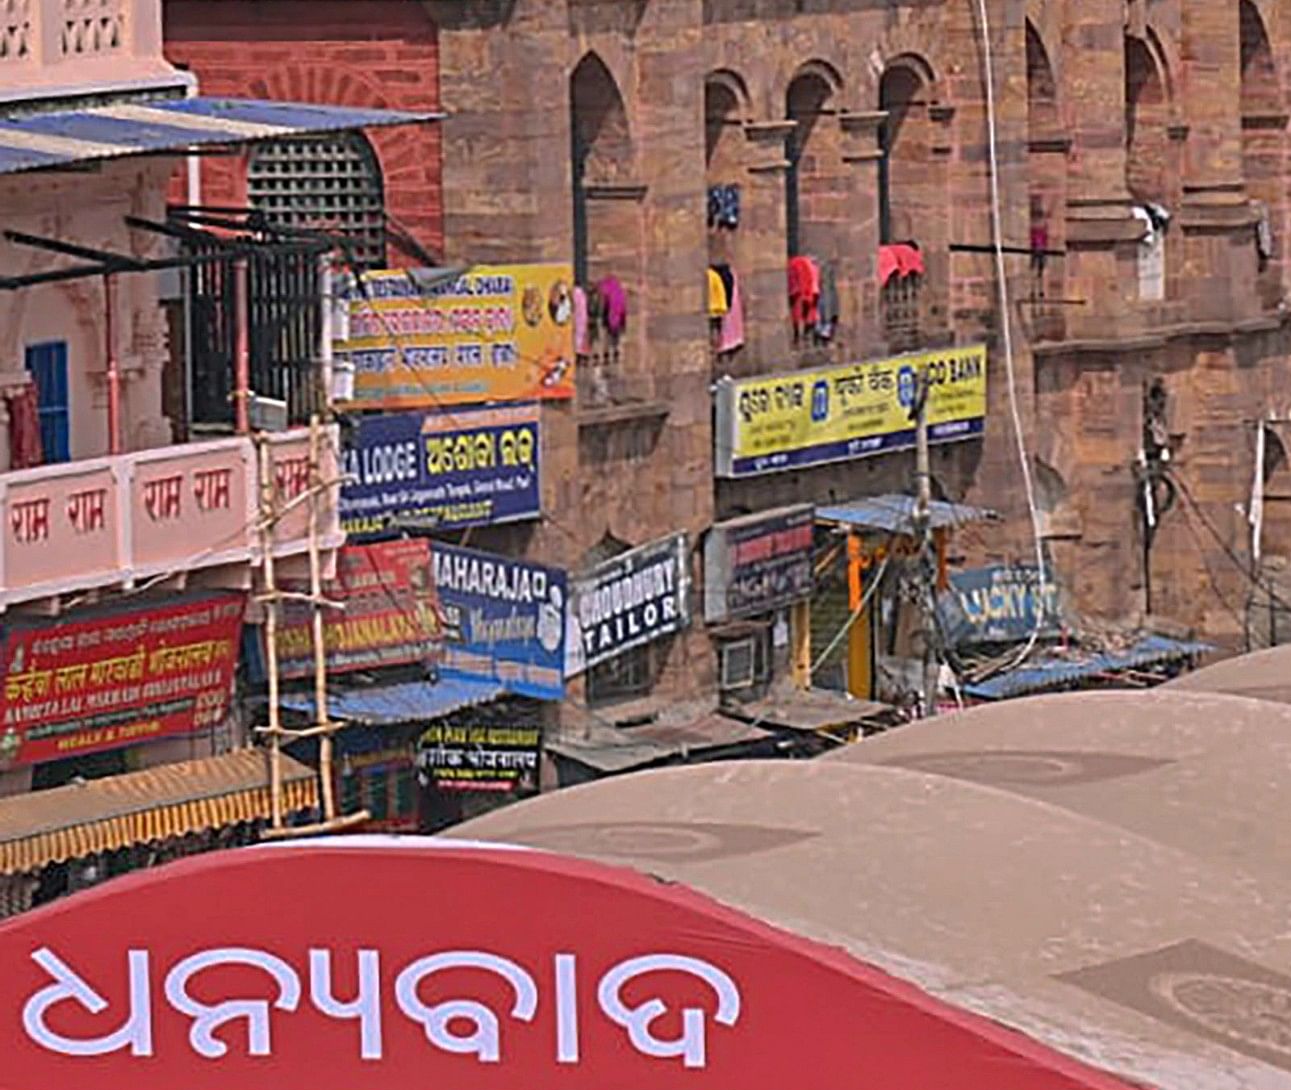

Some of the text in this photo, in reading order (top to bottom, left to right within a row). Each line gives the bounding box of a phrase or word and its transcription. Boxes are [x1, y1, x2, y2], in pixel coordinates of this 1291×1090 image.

[363, 441, 418, 484] LODGE
[11, 489, 107, 542] राम राम
[144, 468, 232, 521] राम राम
[584, 595, 677, 653] TAILOR
[22, 946, 741, 1068] ଧନ୍ୟବାଦ
